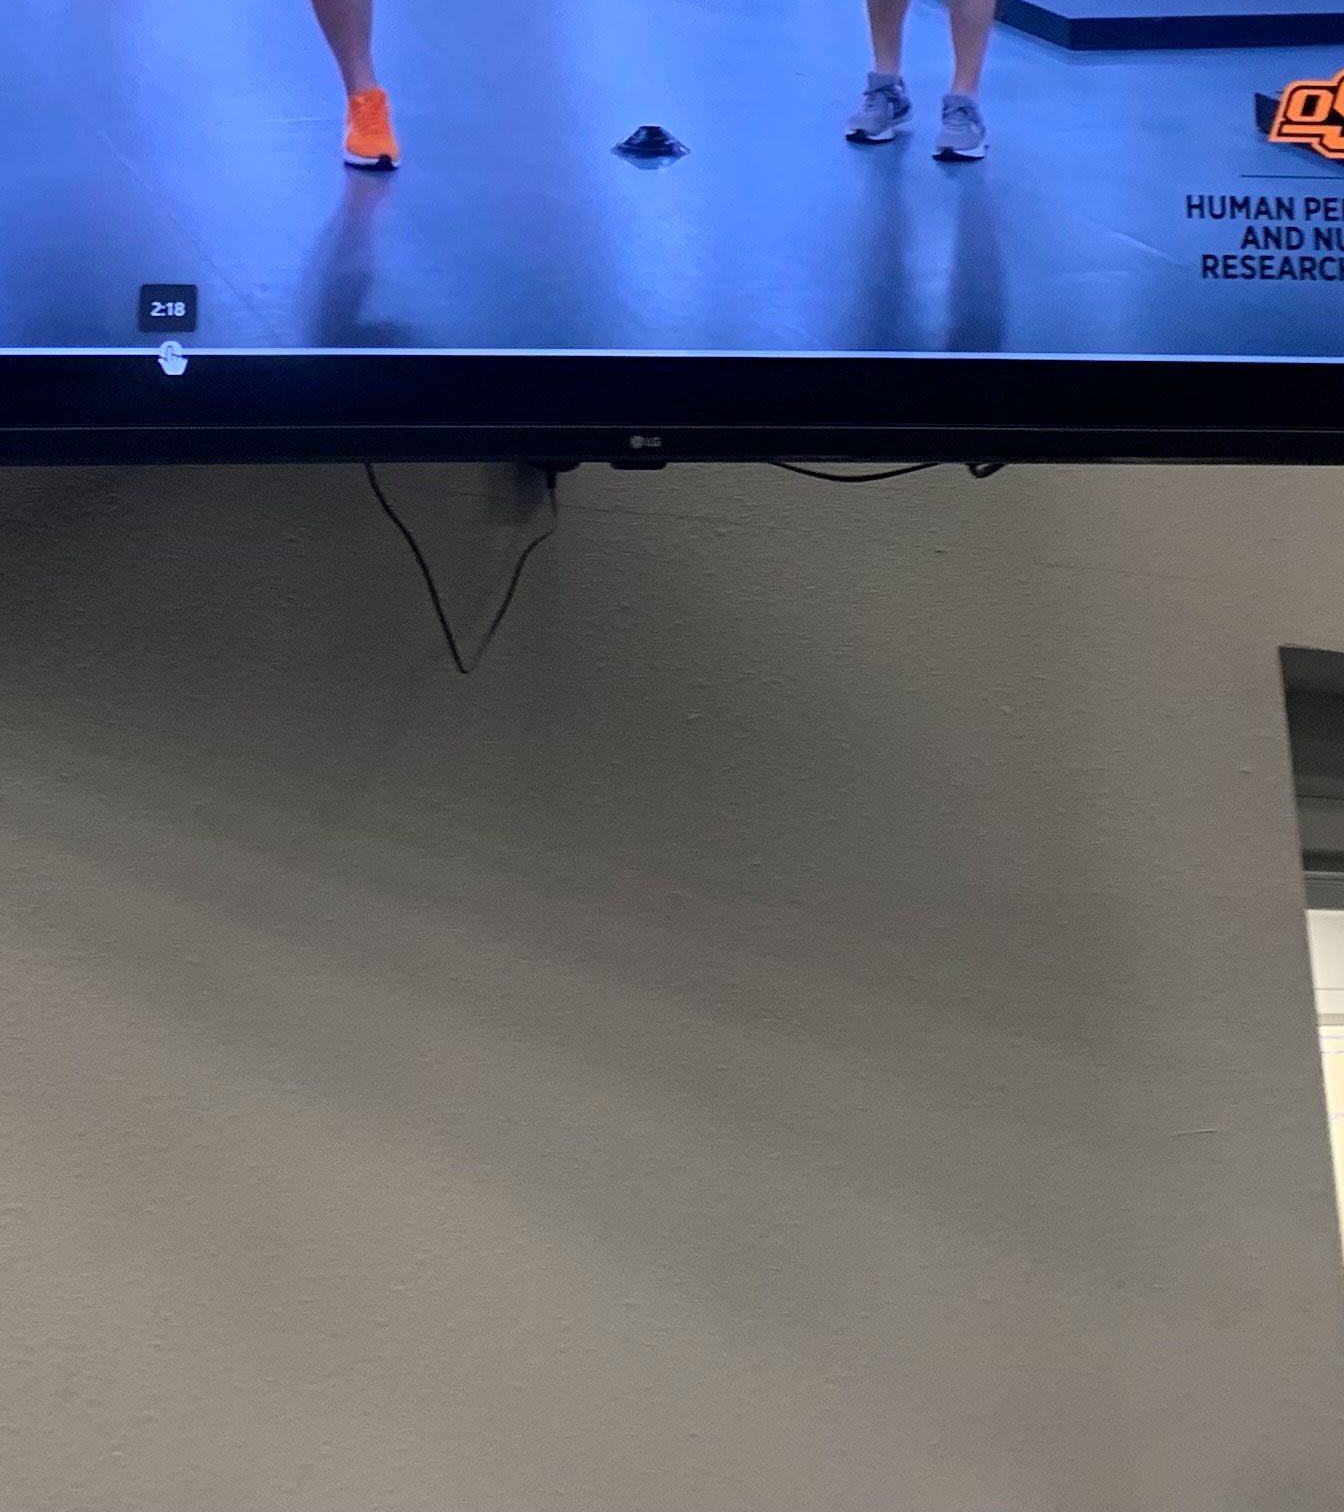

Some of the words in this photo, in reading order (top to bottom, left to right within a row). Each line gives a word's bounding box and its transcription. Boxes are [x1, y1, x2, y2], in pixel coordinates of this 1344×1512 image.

[1185, 194, 1296, 222] HUMAN
[1240, 226, 1303, 251] AND
[150, 301, 186, 317] 2:18
